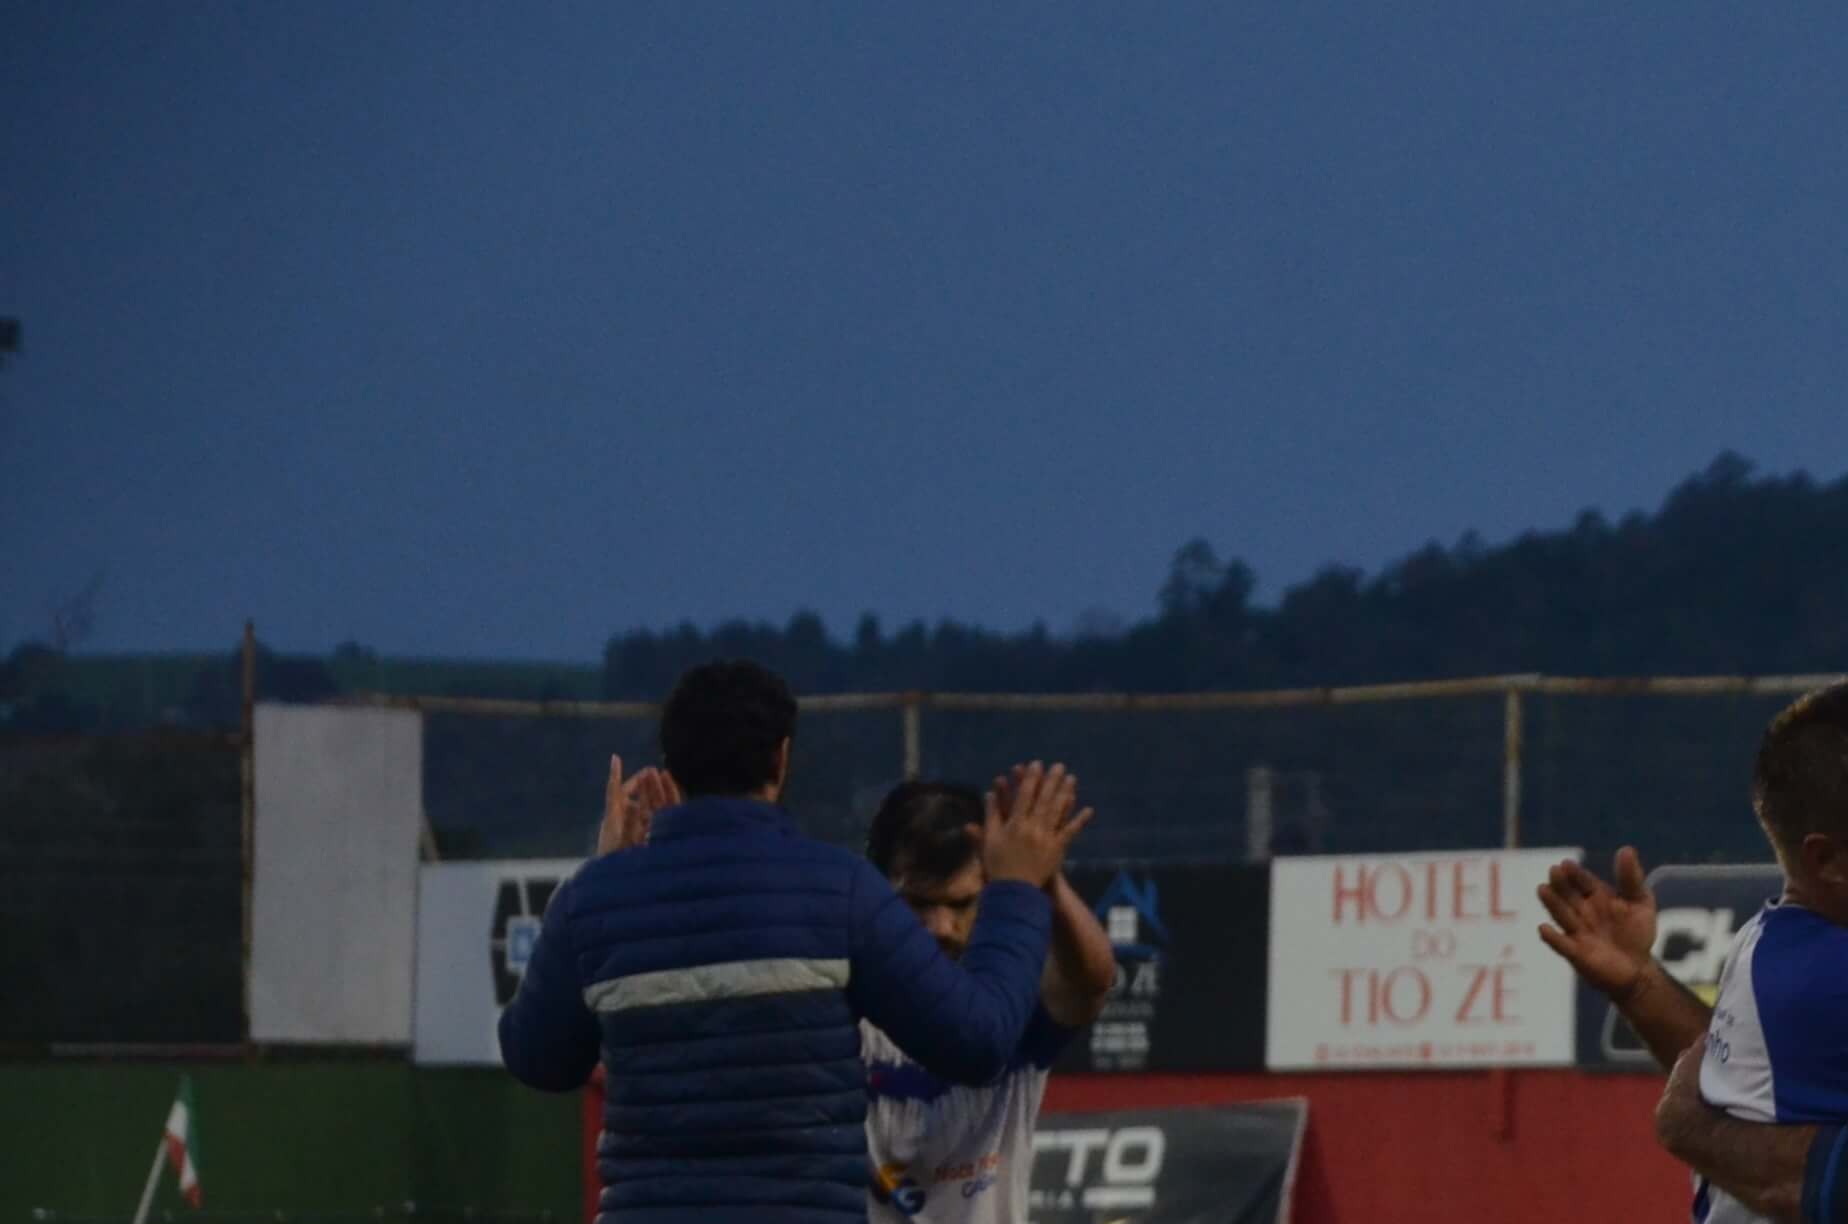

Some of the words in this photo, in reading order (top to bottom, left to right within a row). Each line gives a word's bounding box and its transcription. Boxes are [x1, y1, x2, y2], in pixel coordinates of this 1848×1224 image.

[1331, 861, 1518, 925] HOTEL
[1327, 966, 1432, 1027] TIO
[1455, 944, 1526, 1025] ZÉ
